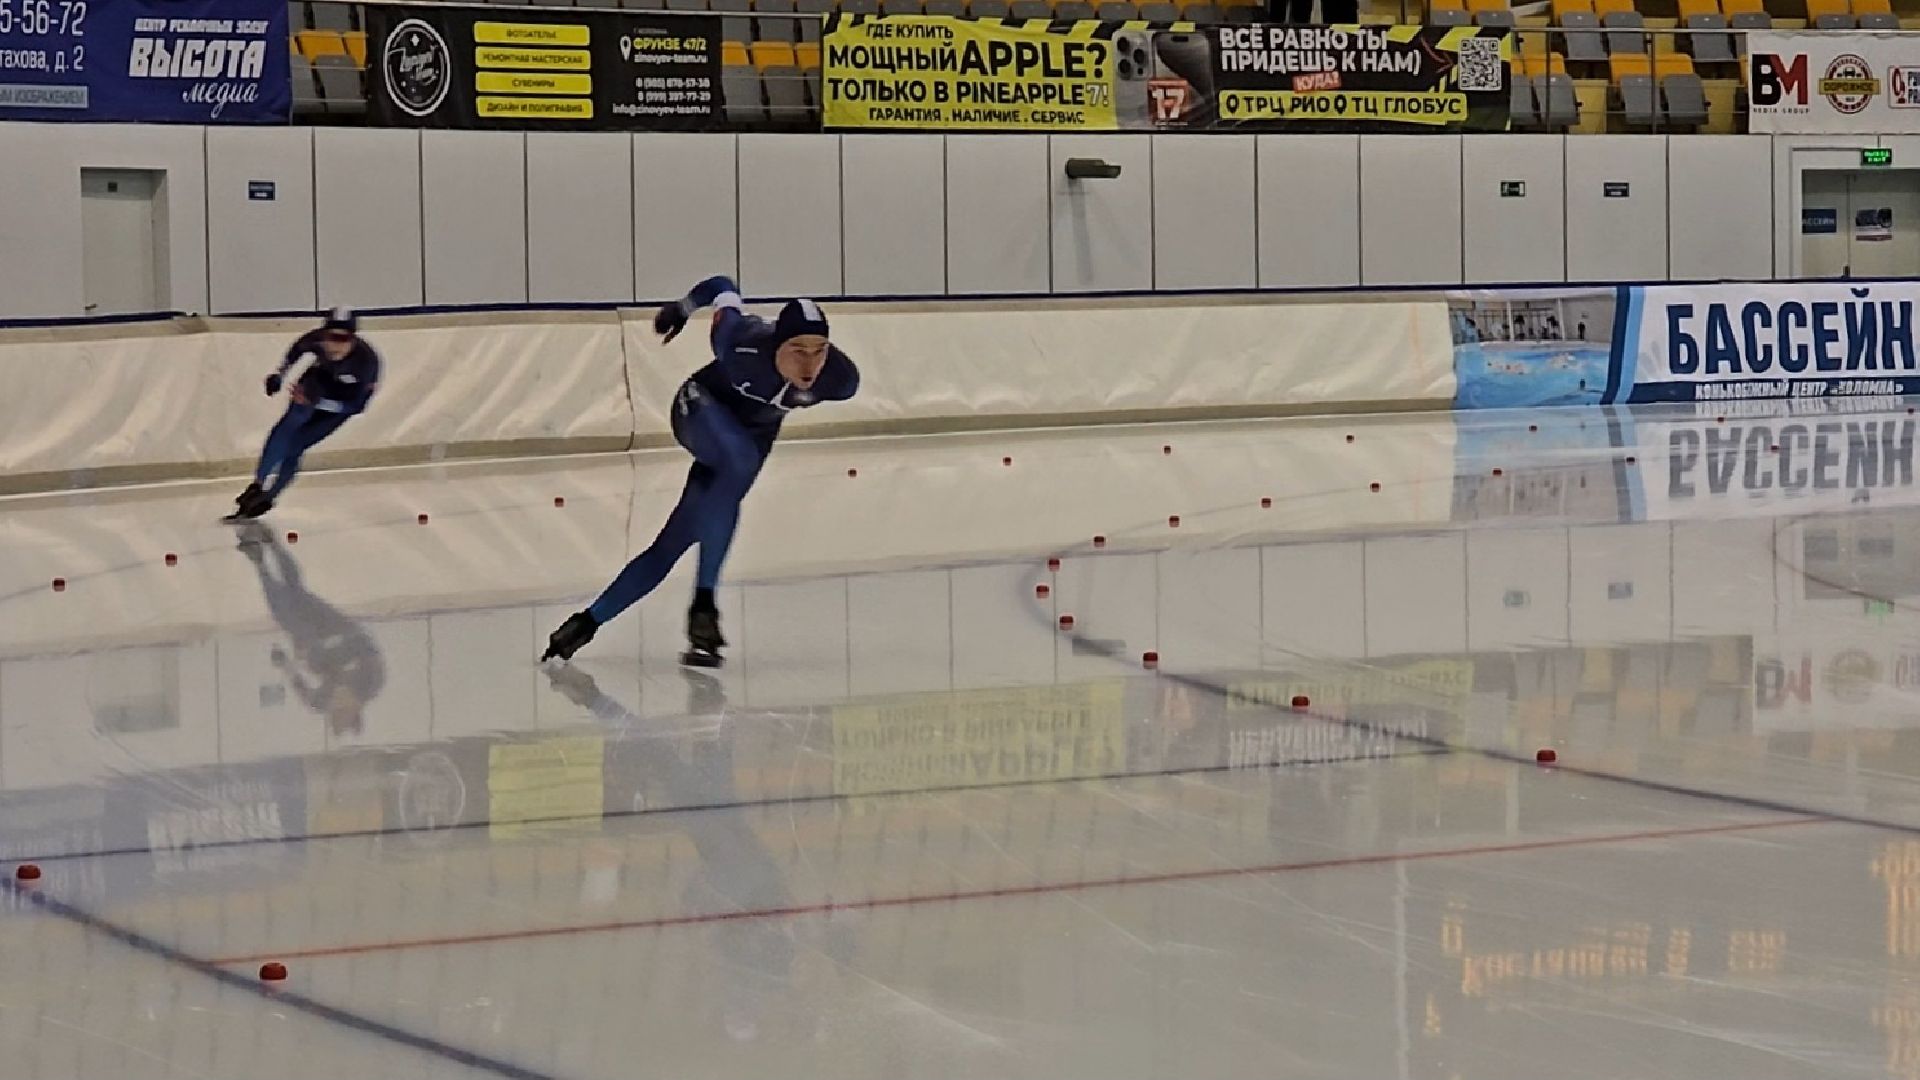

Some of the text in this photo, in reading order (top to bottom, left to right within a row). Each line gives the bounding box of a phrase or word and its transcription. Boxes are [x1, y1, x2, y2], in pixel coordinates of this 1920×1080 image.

[633, 37, 707, 52] ФРУНЗЕ 47/2
[866, 23, 954, 40] ГДЕ КУПИТЬ
[1219, 23, 1388, 51] ВСЁ РАВНО ТЫ
[55, 50, 69, 73] д.
[73, 45, 84, 71] 2
[129, 38, 267, 77] ВЫСОТА
[828, 40, 1108, 79] МОЩНЫЙ APPLE?
[1221, 49, 1422, 76] ПРИДЕШЬ К НАМ)
[182, 82, 259, 118] медиа
[828, 77, 927, 102] ТОЛЬКО
[934, 80, 949, 102] В
[1152, 88, 1185, 119] 17
[869, 106, 1085, 125] ГАРАНТИЯ НАЛИЧИЕ СЕРВИС
[1244, 97, 1462, 117] ТРЦ РИО ТЦ ГЛОБУС
[1666, 287, 1915, 374] БАССЕЙН
